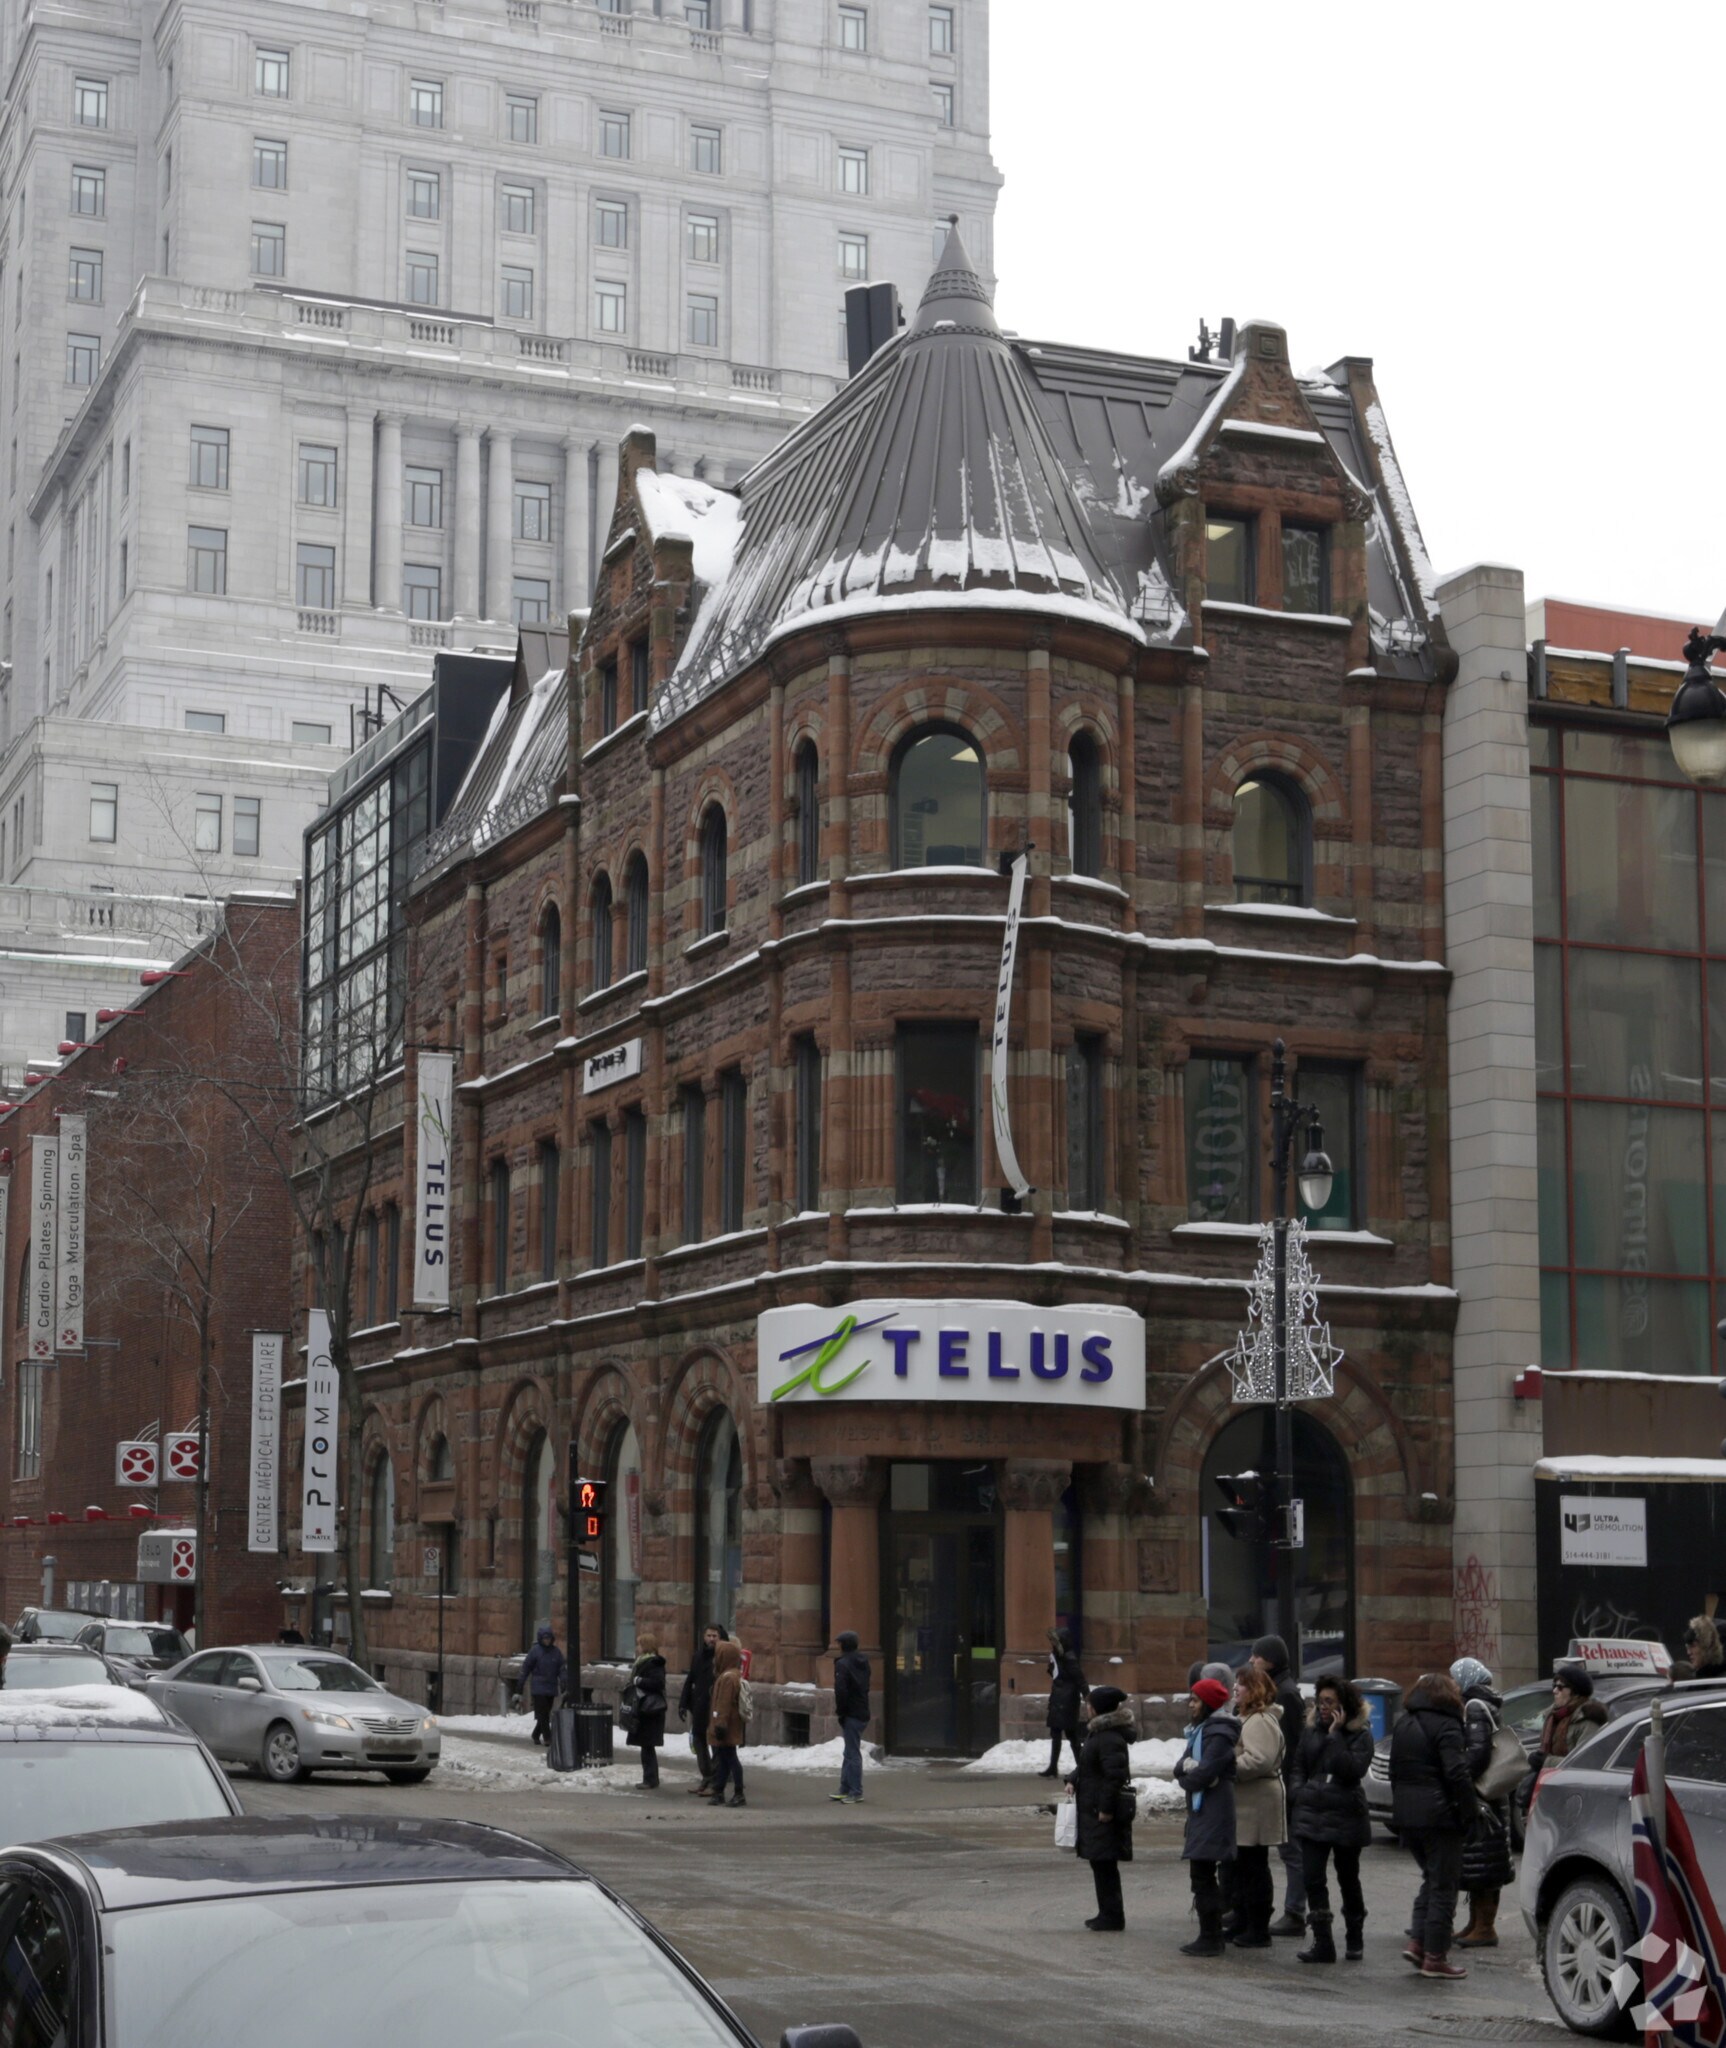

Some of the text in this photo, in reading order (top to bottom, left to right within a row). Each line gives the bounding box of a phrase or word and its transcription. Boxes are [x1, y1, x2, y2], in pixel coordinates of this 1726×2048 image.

[995, 908, 1017, 1055] TELUS
[38, 1149, 56, 1328] Cardio Pilates Spinning
[66, 1134, 84, 1311] Yoga Musculation Spa
[425, 1160, 445, 1266] TELUS
[882, 1329, 1114, 1383] TELUS
[256, 1341, 276, 1544] CENTRE MÉDICAL ET DENTAIRE
[1593, 1515, 1619, 1523] ULTRA
[1307, 1629, 1345, 1639] TELUS
[1576, 1643, 1648, 1660] Rehausse
